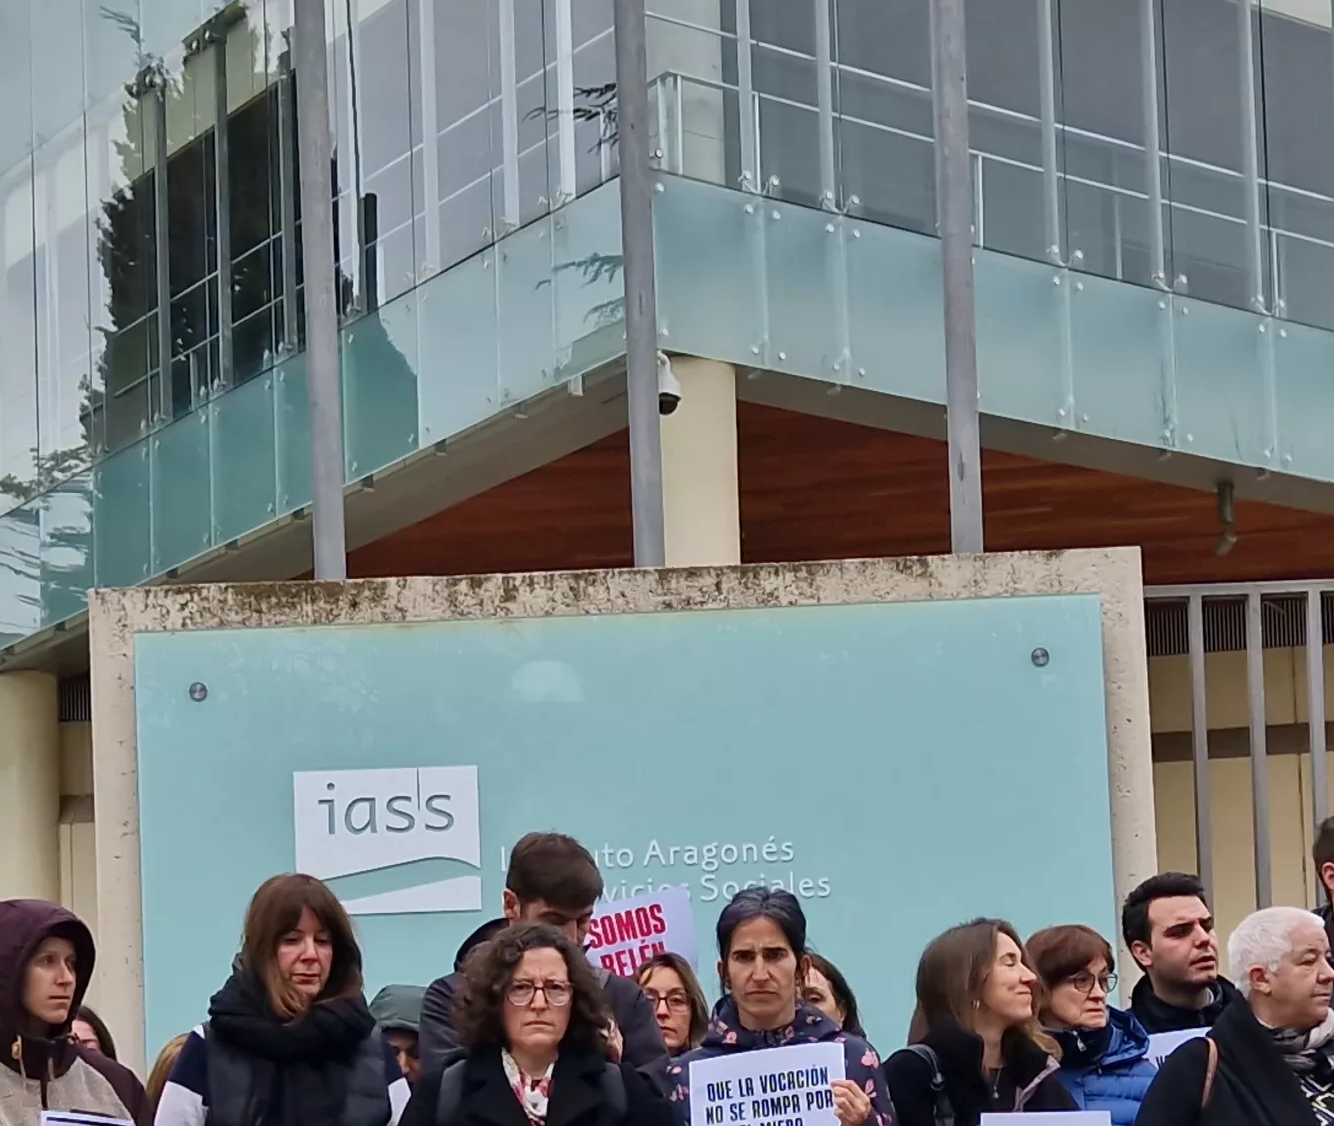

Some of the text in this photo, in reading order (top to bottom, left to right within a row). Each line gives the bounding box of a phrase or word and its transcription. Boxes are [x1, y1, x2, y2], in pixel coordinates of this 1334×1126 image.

[643, 836, 794, 873] Aragonés
[588, 903, 666, 950] SOMOS
[706, 1065, 829, 1103] QUE LA VOCACIÓN
[705, 1089, 834, 1125] NO SE ROMPA POR
